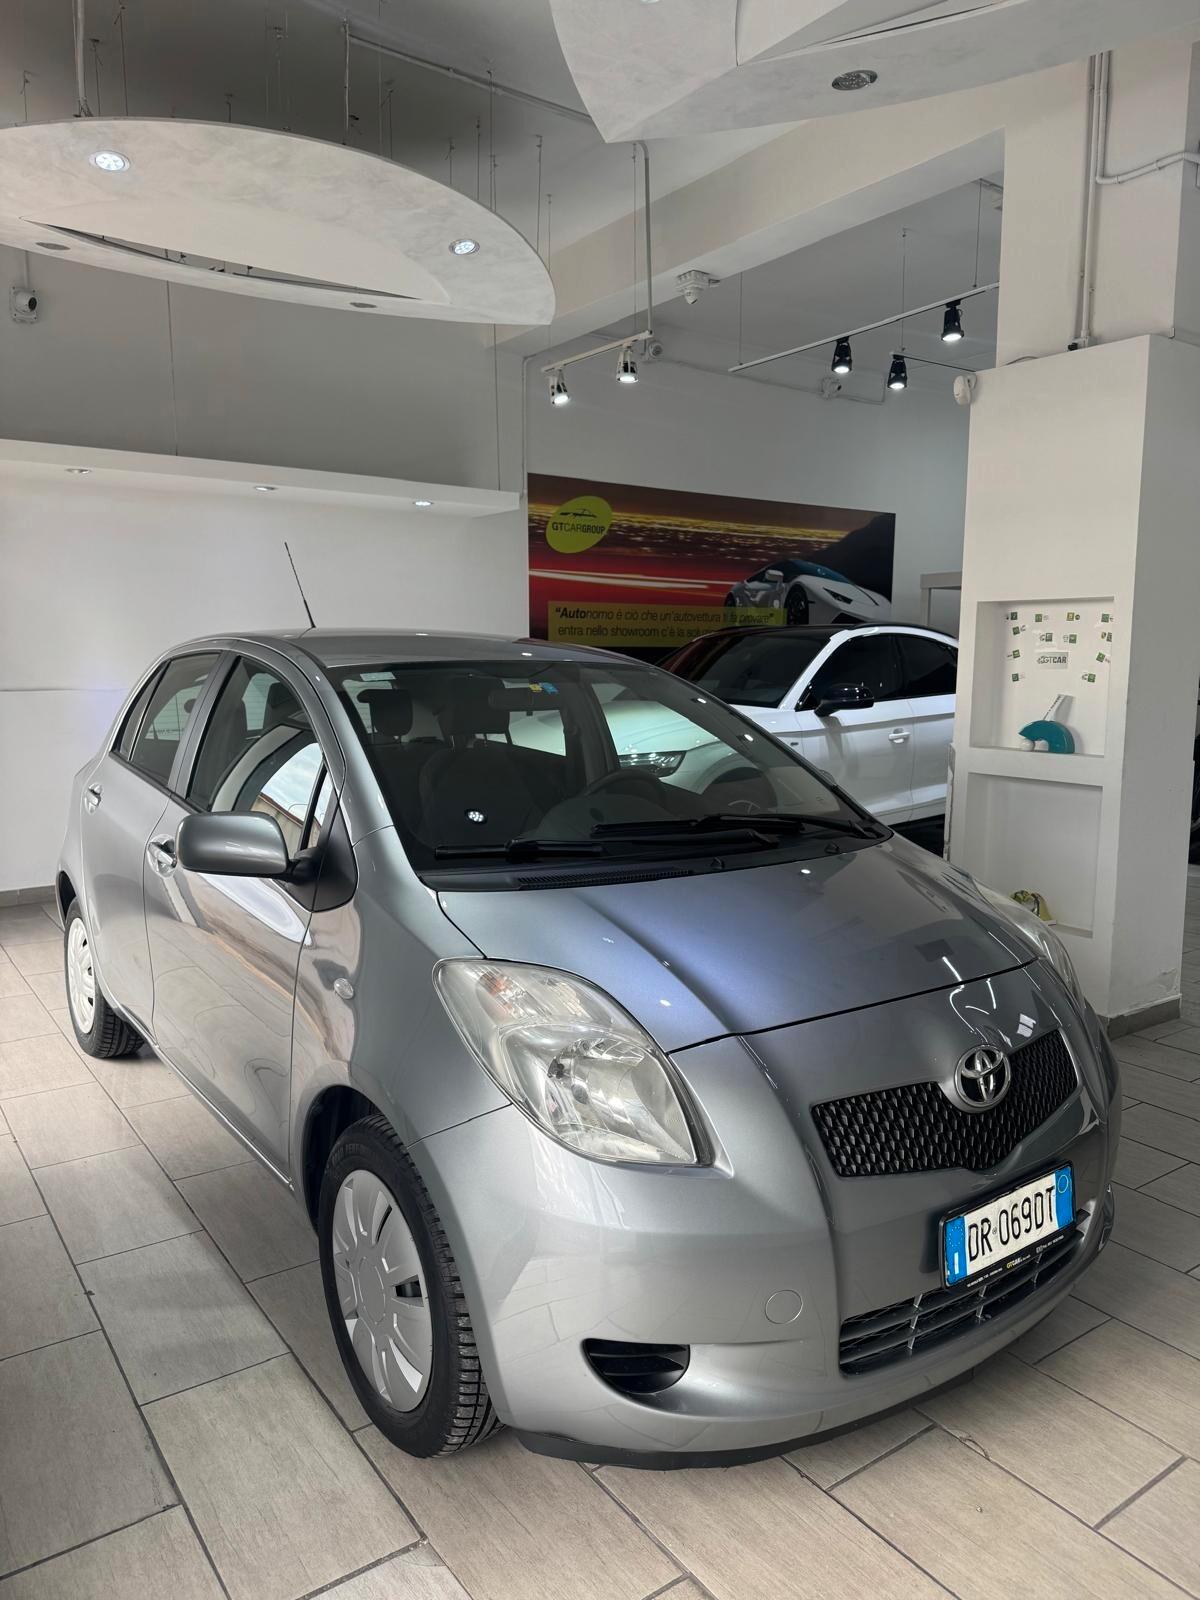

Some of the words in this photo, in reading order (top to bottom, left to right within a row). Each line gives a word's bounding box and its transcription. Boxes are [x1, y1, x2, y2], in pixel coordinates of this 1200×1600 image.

[640, 609, 658, 621] che
[558, 625, 584, 636] entra
[585, 624, 609, 636] nello
[610, 625, 660, 637] showroom
[967, 1217, 993, 1262] DR
[998, 1185, 1056, 1246] 069DT
